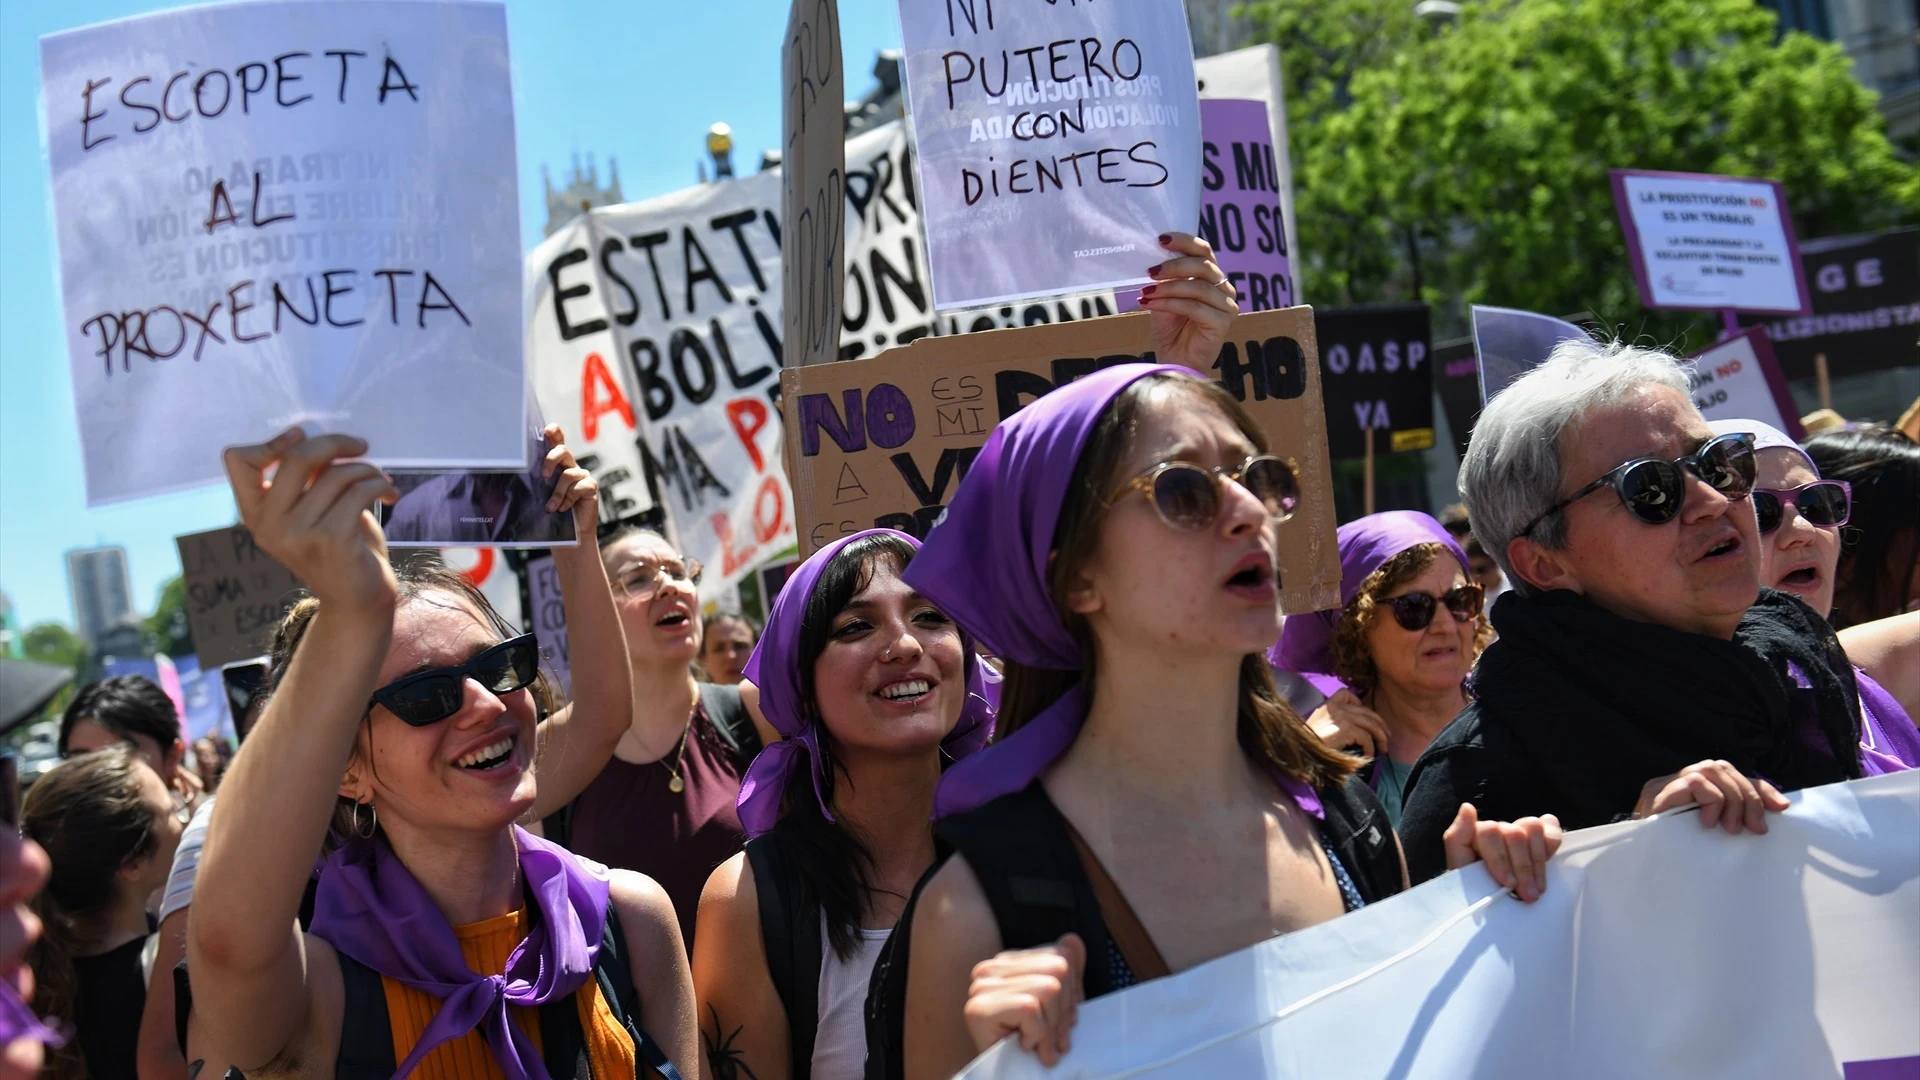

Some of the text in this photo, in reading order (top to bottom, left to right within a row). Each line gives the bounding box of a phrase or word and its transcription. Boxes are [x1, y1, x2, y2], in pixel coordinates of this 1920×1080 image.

[942, 37, 1142, 110] PUTERO
[81, 47, 420, 151] ESCOPETA
[1012, 99, 1085, 141] CON
[205, 173, 296, 234] AL
[1640, 191, 1767, 210] LA PROSTITUCIÓN NO
[1662, 211, 1755, 226] ES UN TRABAJO
[81, 270, 471, 375] PROXENETA
[1715, 359, 1743, 379] NO
[797, 375, 983, 457] NO ES
[936, 407, 987, 436] MI
[1353, 398, 1391, 431] YA
[835, 461, 869, 500] A
[459, 516, 494, 524] FEMINISTES.CAT
